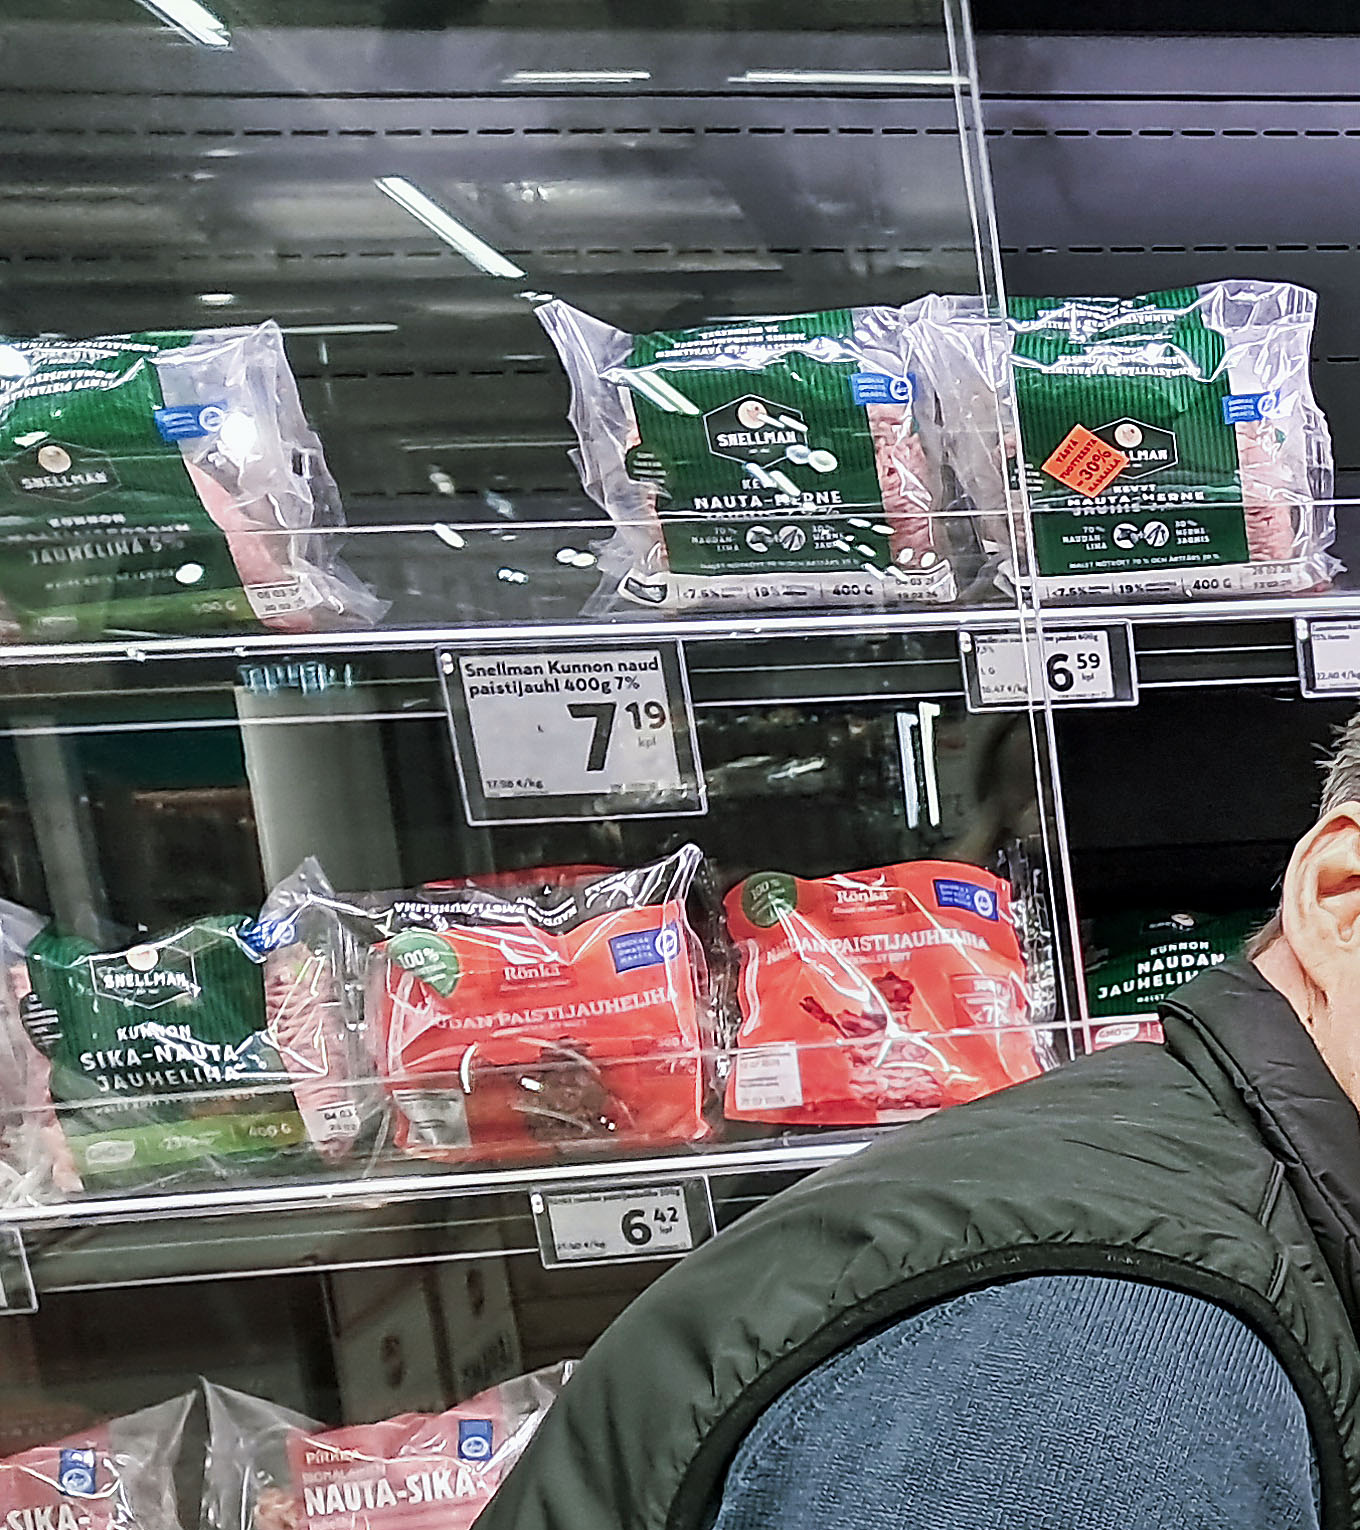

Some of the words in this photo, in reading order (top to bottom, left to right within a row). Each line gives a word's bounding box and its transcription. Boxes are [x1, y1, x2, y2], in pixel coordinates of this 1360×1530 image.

[717, 431, 797, 448] SNELLMAN
[1127, 449, 1168, 462] LLMAN
[21, 471, 109, 491] SNELLMAN
[1192, 580, 1219, 590] 400
[464, 660, 544, 679] Snellman
[547, 658, 614, 676] Kunnon
[617, 655, 660, 673] naud
[1046, 652, 1075, 693] 6
[1076, 652, 1101, 670] 59
[563, 677, 613, 695] 400g
[614, 675, 642, 691] 7%
[565, 700, 618, 773] 7
[625, 699, 667, 731] 19
[836, 888, 890, 905] Rönkä
[503, 962, 561, 982] Rönkä
[1136, 952, 1226, 976] NAUDAN
[103, 972, 189, 989] SNELLMAN
[80, 1043, 239, 1072] SIKA-NAUTA
[96, 1065, 241, 1093] JAUHELIHA
[621, 1208, 653, 1247] 6
[653, 1206, 679, 1223] 42
